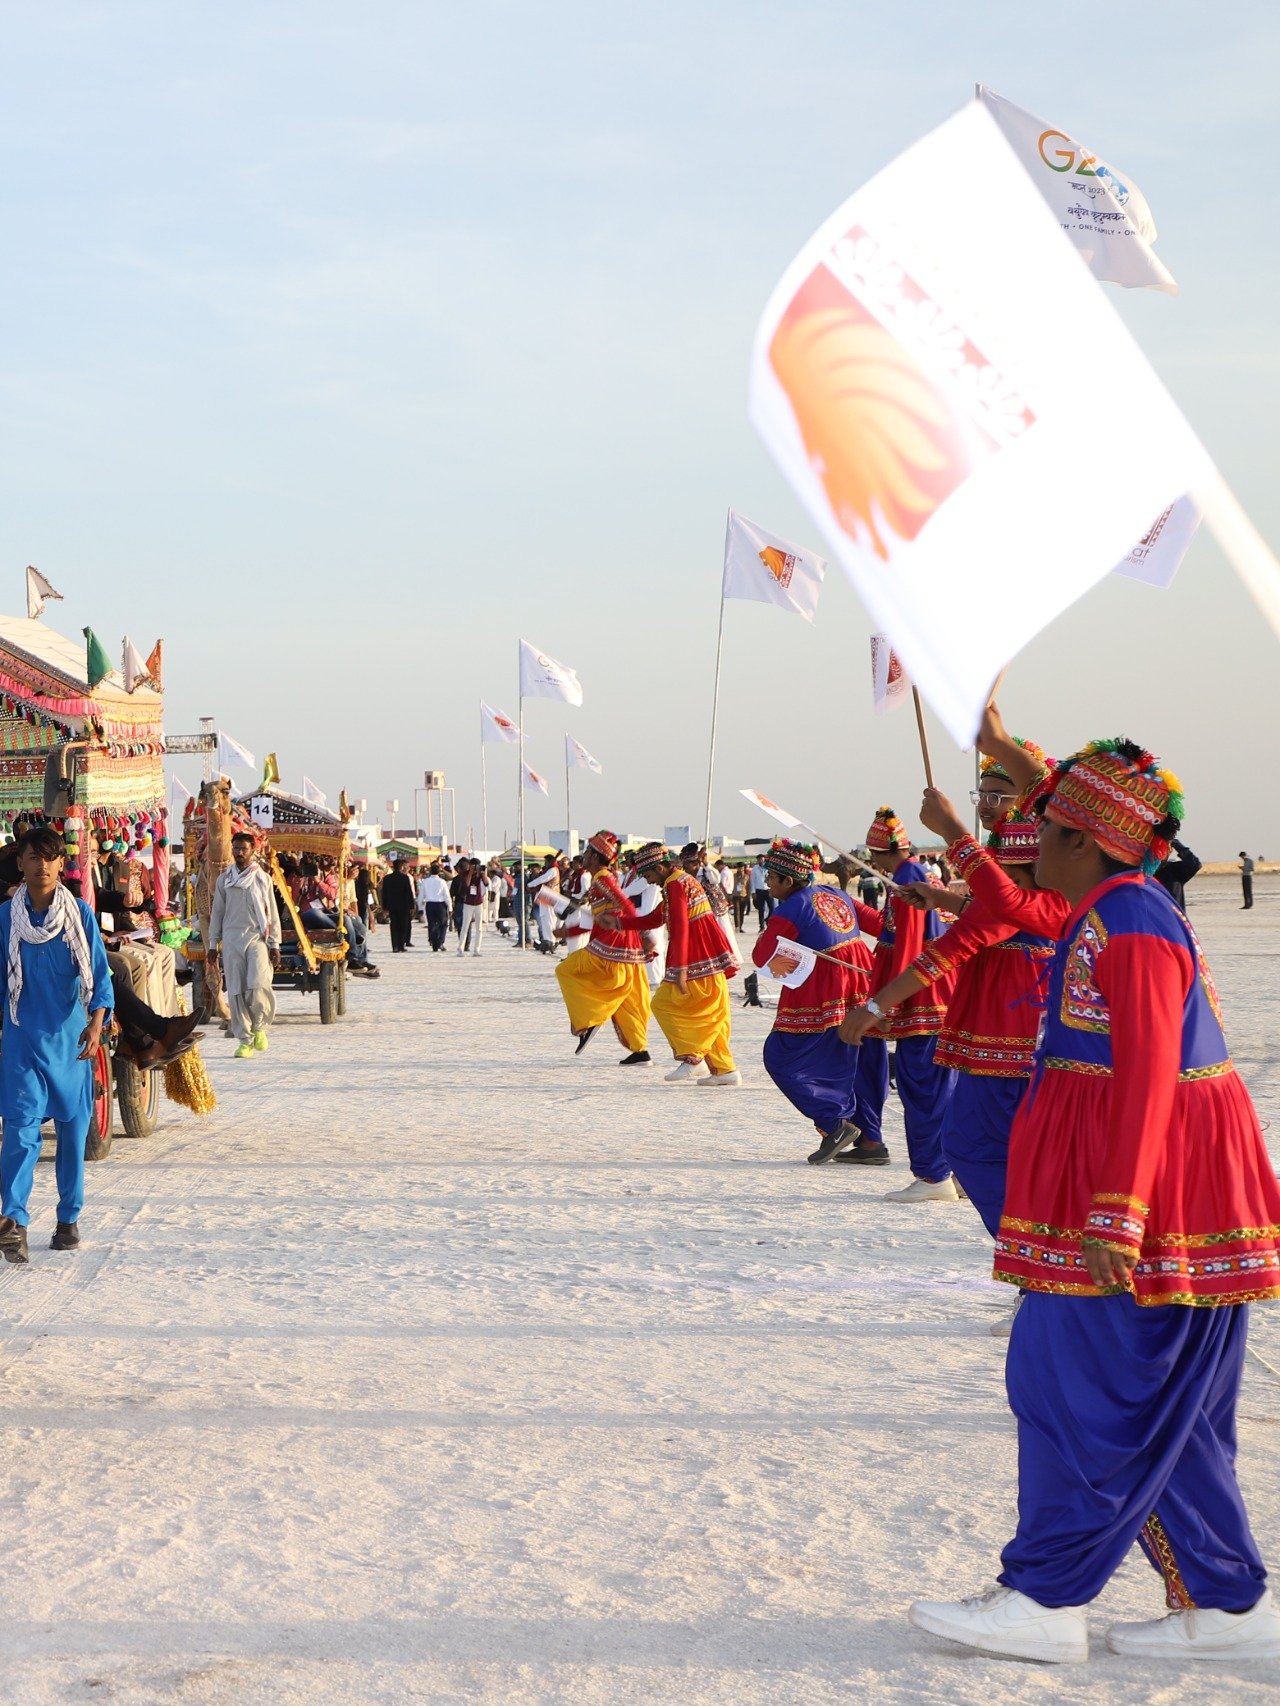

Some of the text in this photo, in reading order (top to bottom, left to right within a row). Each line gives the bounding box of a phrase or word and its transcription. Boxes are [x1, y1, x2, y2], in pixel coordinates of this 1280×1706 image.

[1078, 223, 1094, 231] ONE
[1094, 226, 1116, 236] FAMILY
[253, 804, 270, 814] 14
